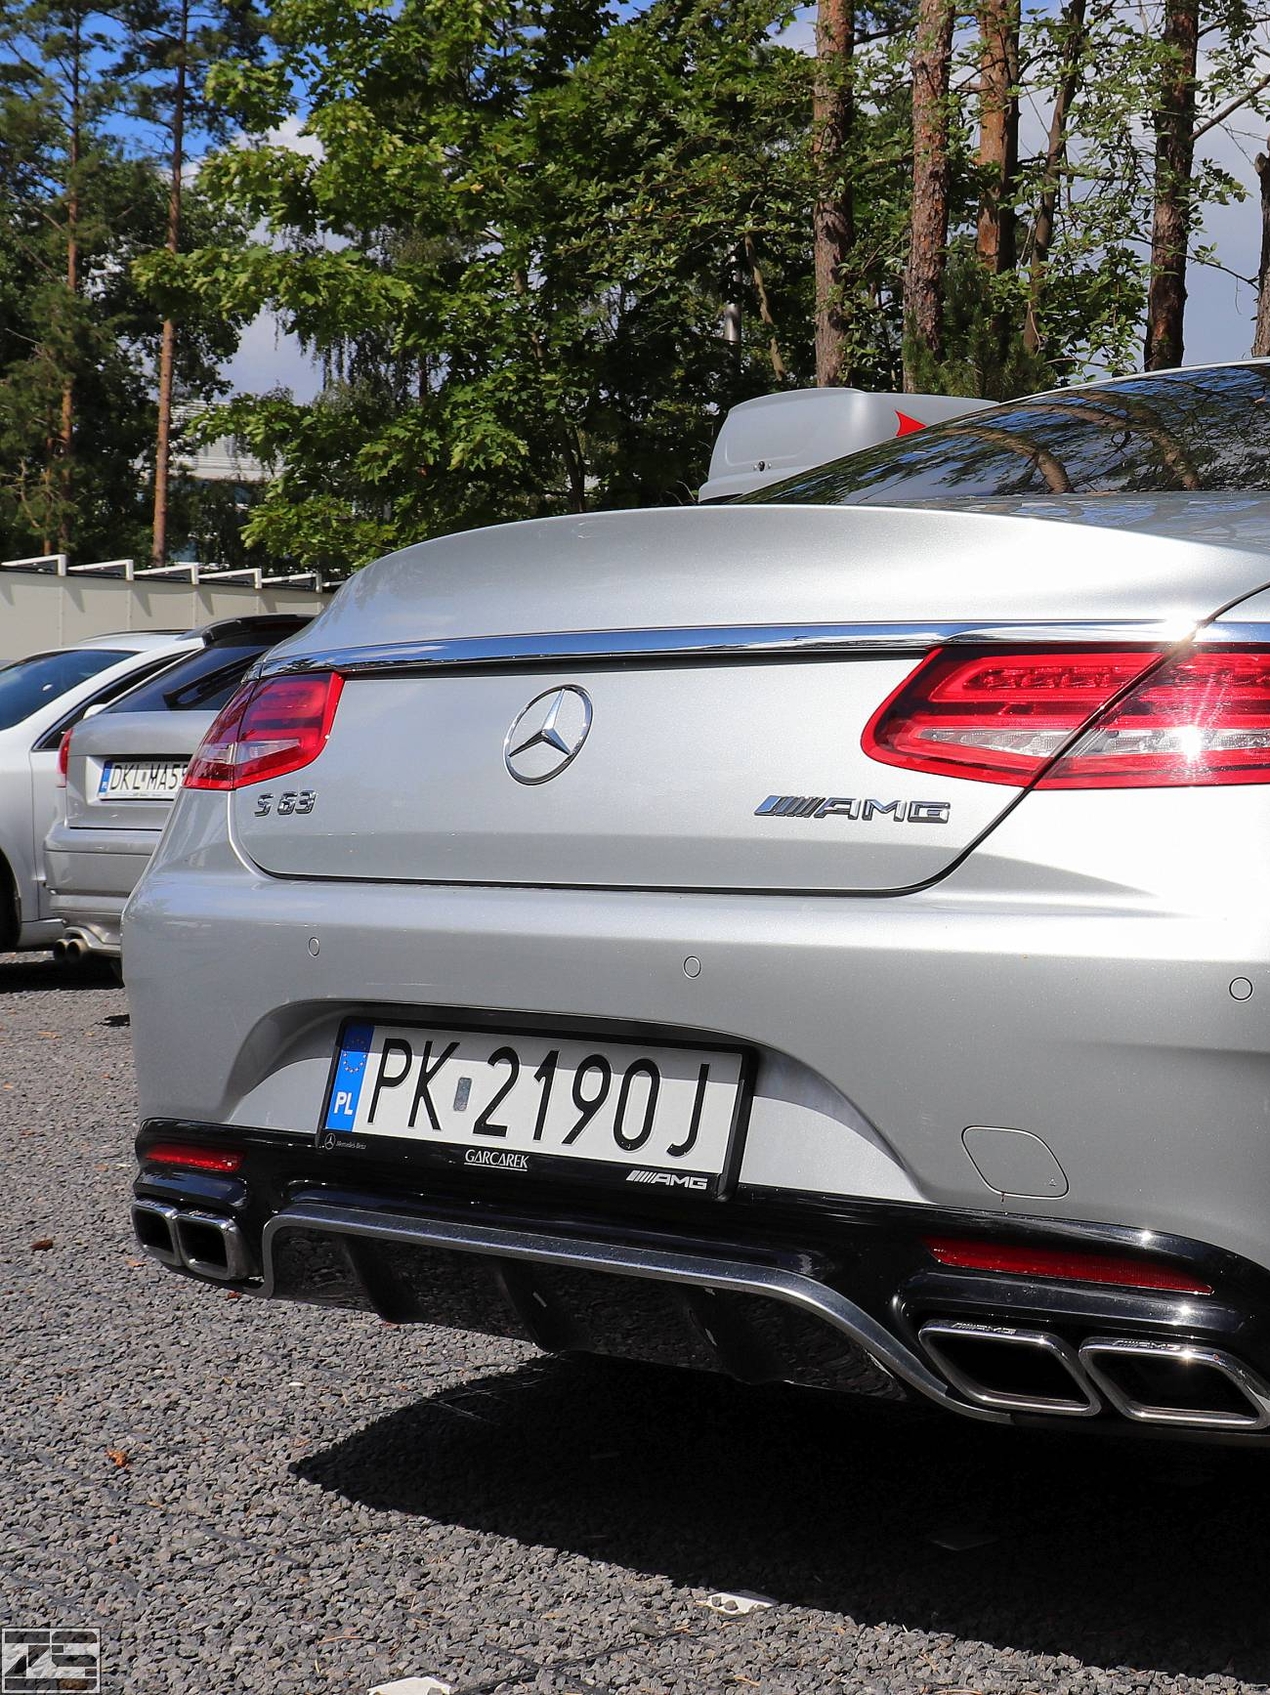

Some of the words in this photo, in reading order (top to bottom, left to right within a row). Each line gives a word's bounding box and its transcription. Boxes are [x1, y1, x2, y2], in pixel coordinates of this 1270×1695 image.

[110, 764, 140, 790] DKL
[254, 792, 274, 818] S
[277, 789, 317, 816] 63
[813, 797, 951, 824] AMG
[333, 1091, 354, 1116] PL
[367, 1036, 460, 1131] PK
[473, 1046, 710, 1158] 2190J
[464, 1149, 530, 1170] GARCAREK
[650, 1172, 708, 1191] AMG
